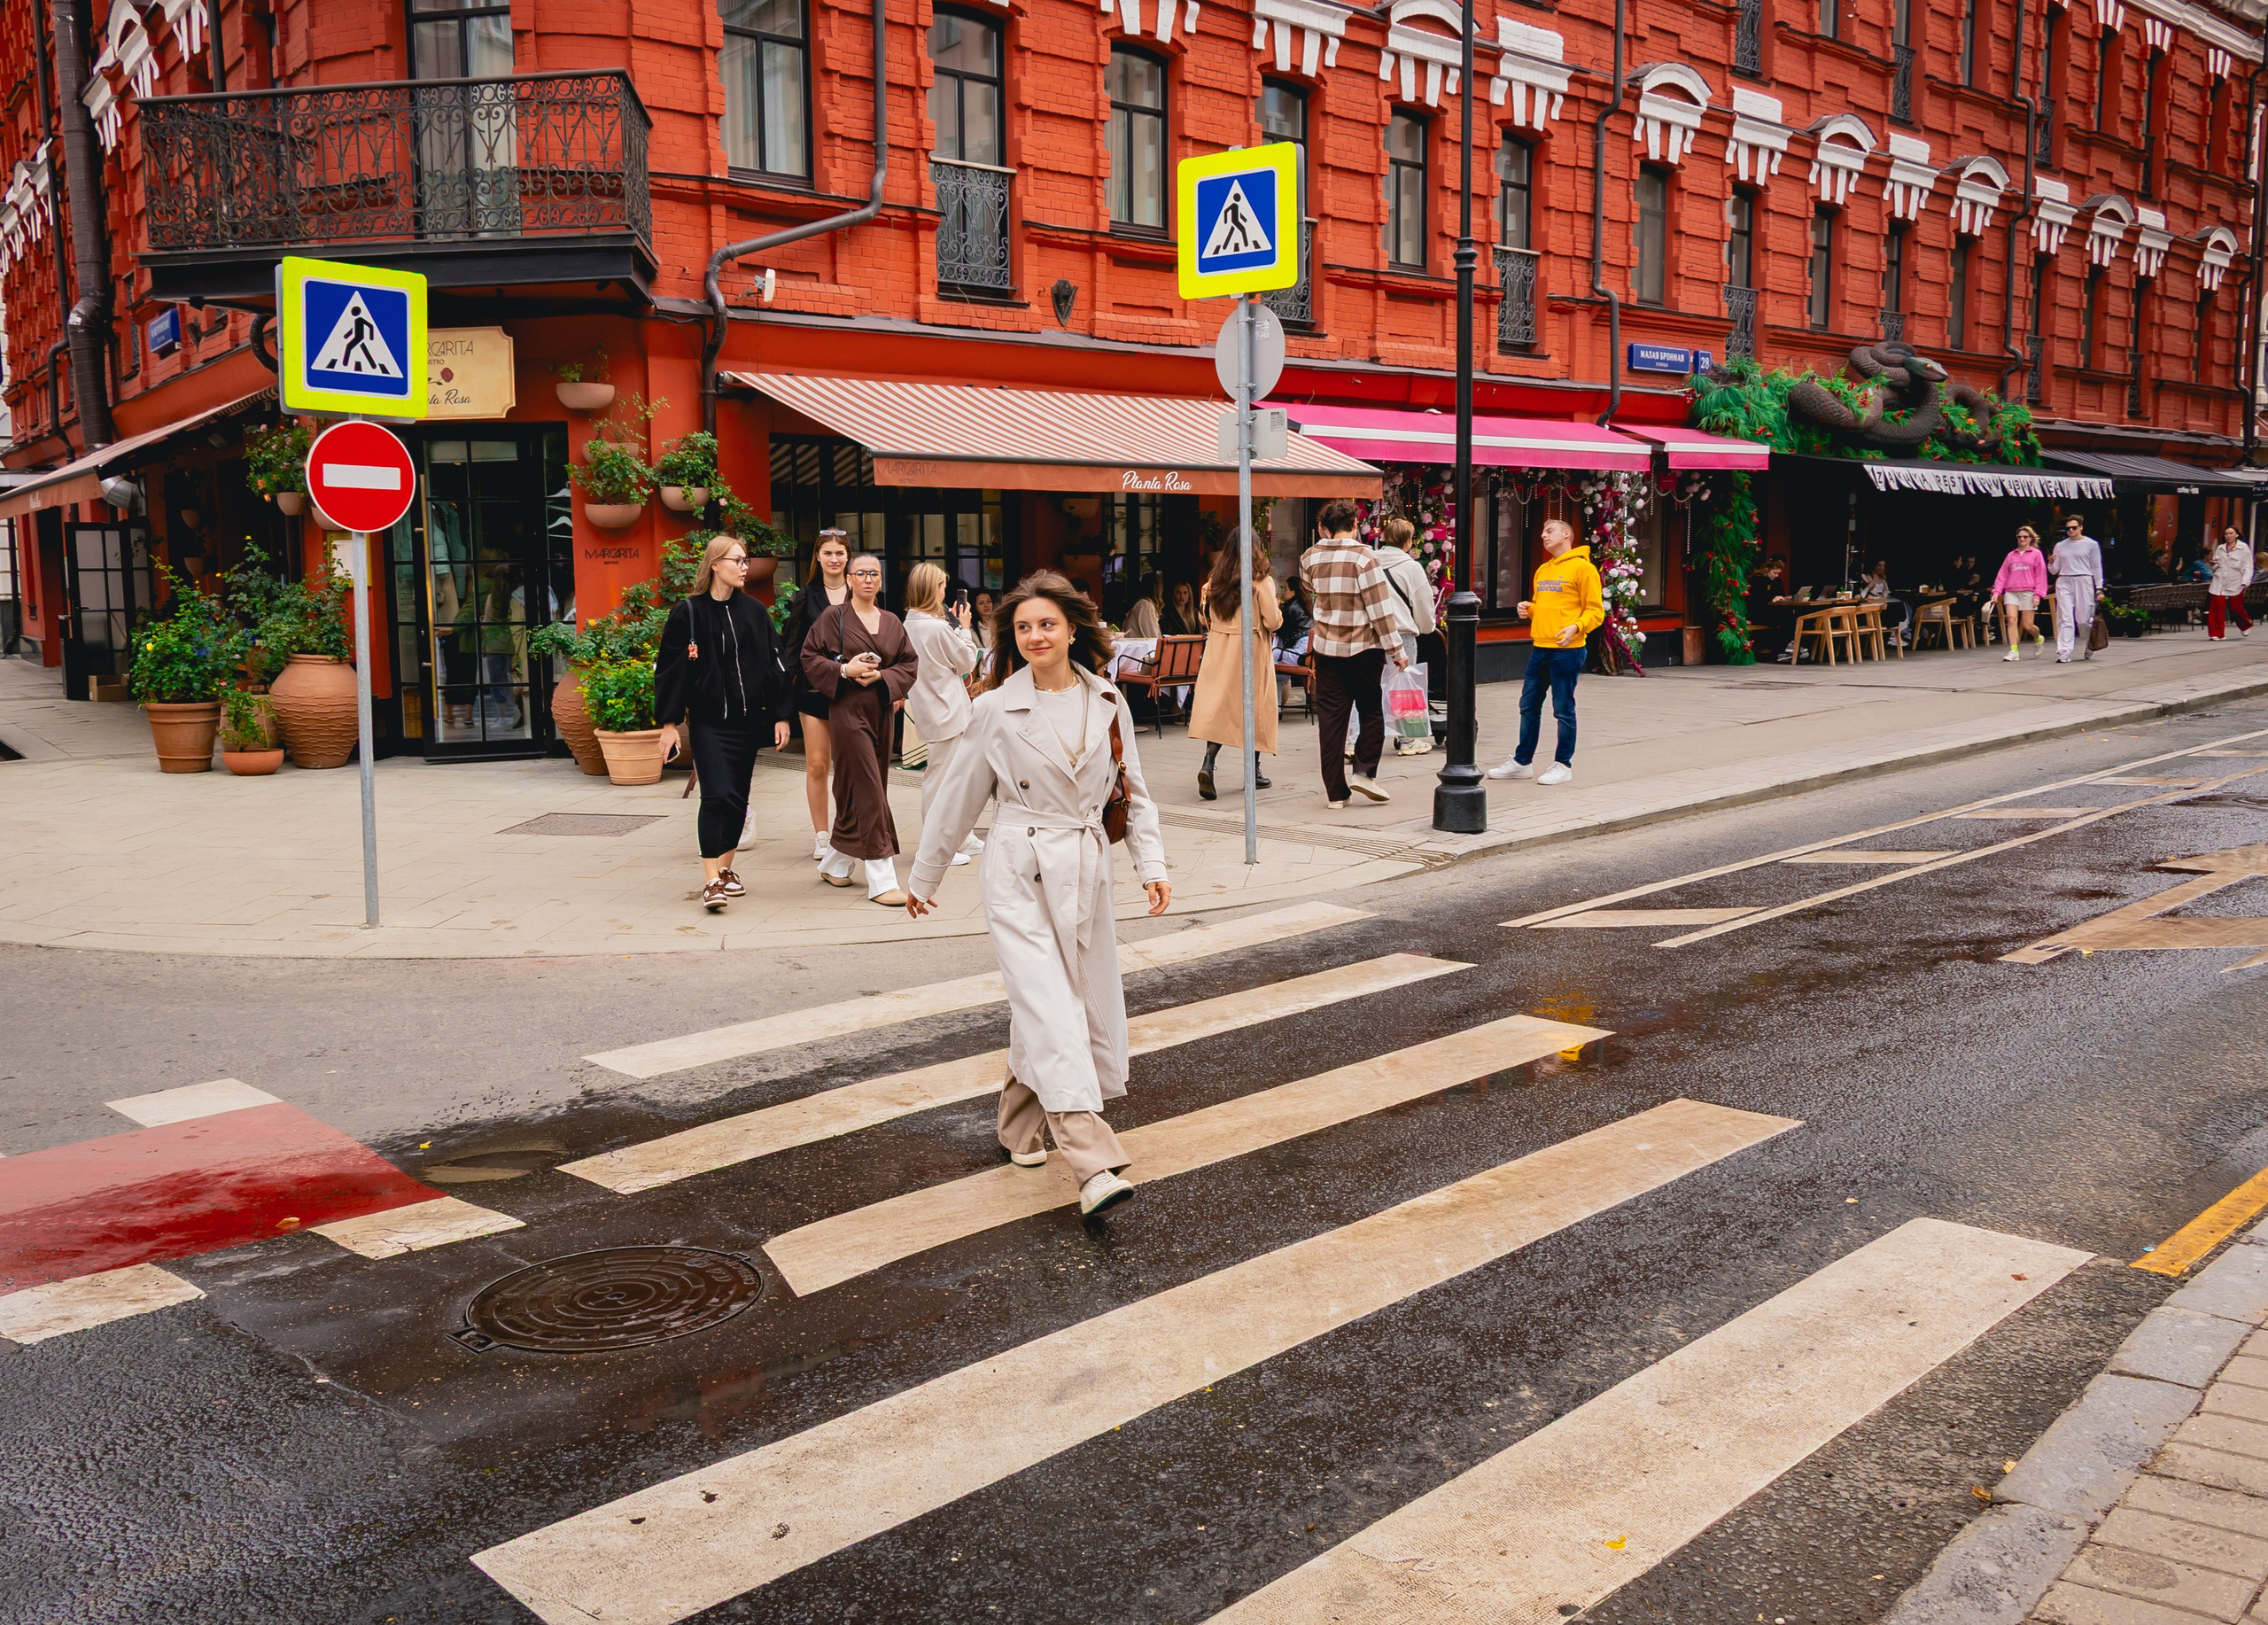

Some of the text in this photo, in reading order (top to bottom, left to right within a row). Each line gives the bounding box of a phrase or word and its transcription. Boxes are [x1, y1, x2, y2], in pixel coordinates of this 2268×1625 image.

[427, 340, 474, 356] RGARITA
[1641, 350, 1685, 362] МАЛАЯ БРОННАЯ
[1700, 356, 1710, 369] 28
[445, 388, 472, 405] Rosa
[1122, 470, 1192, 491] Planta Rosa
